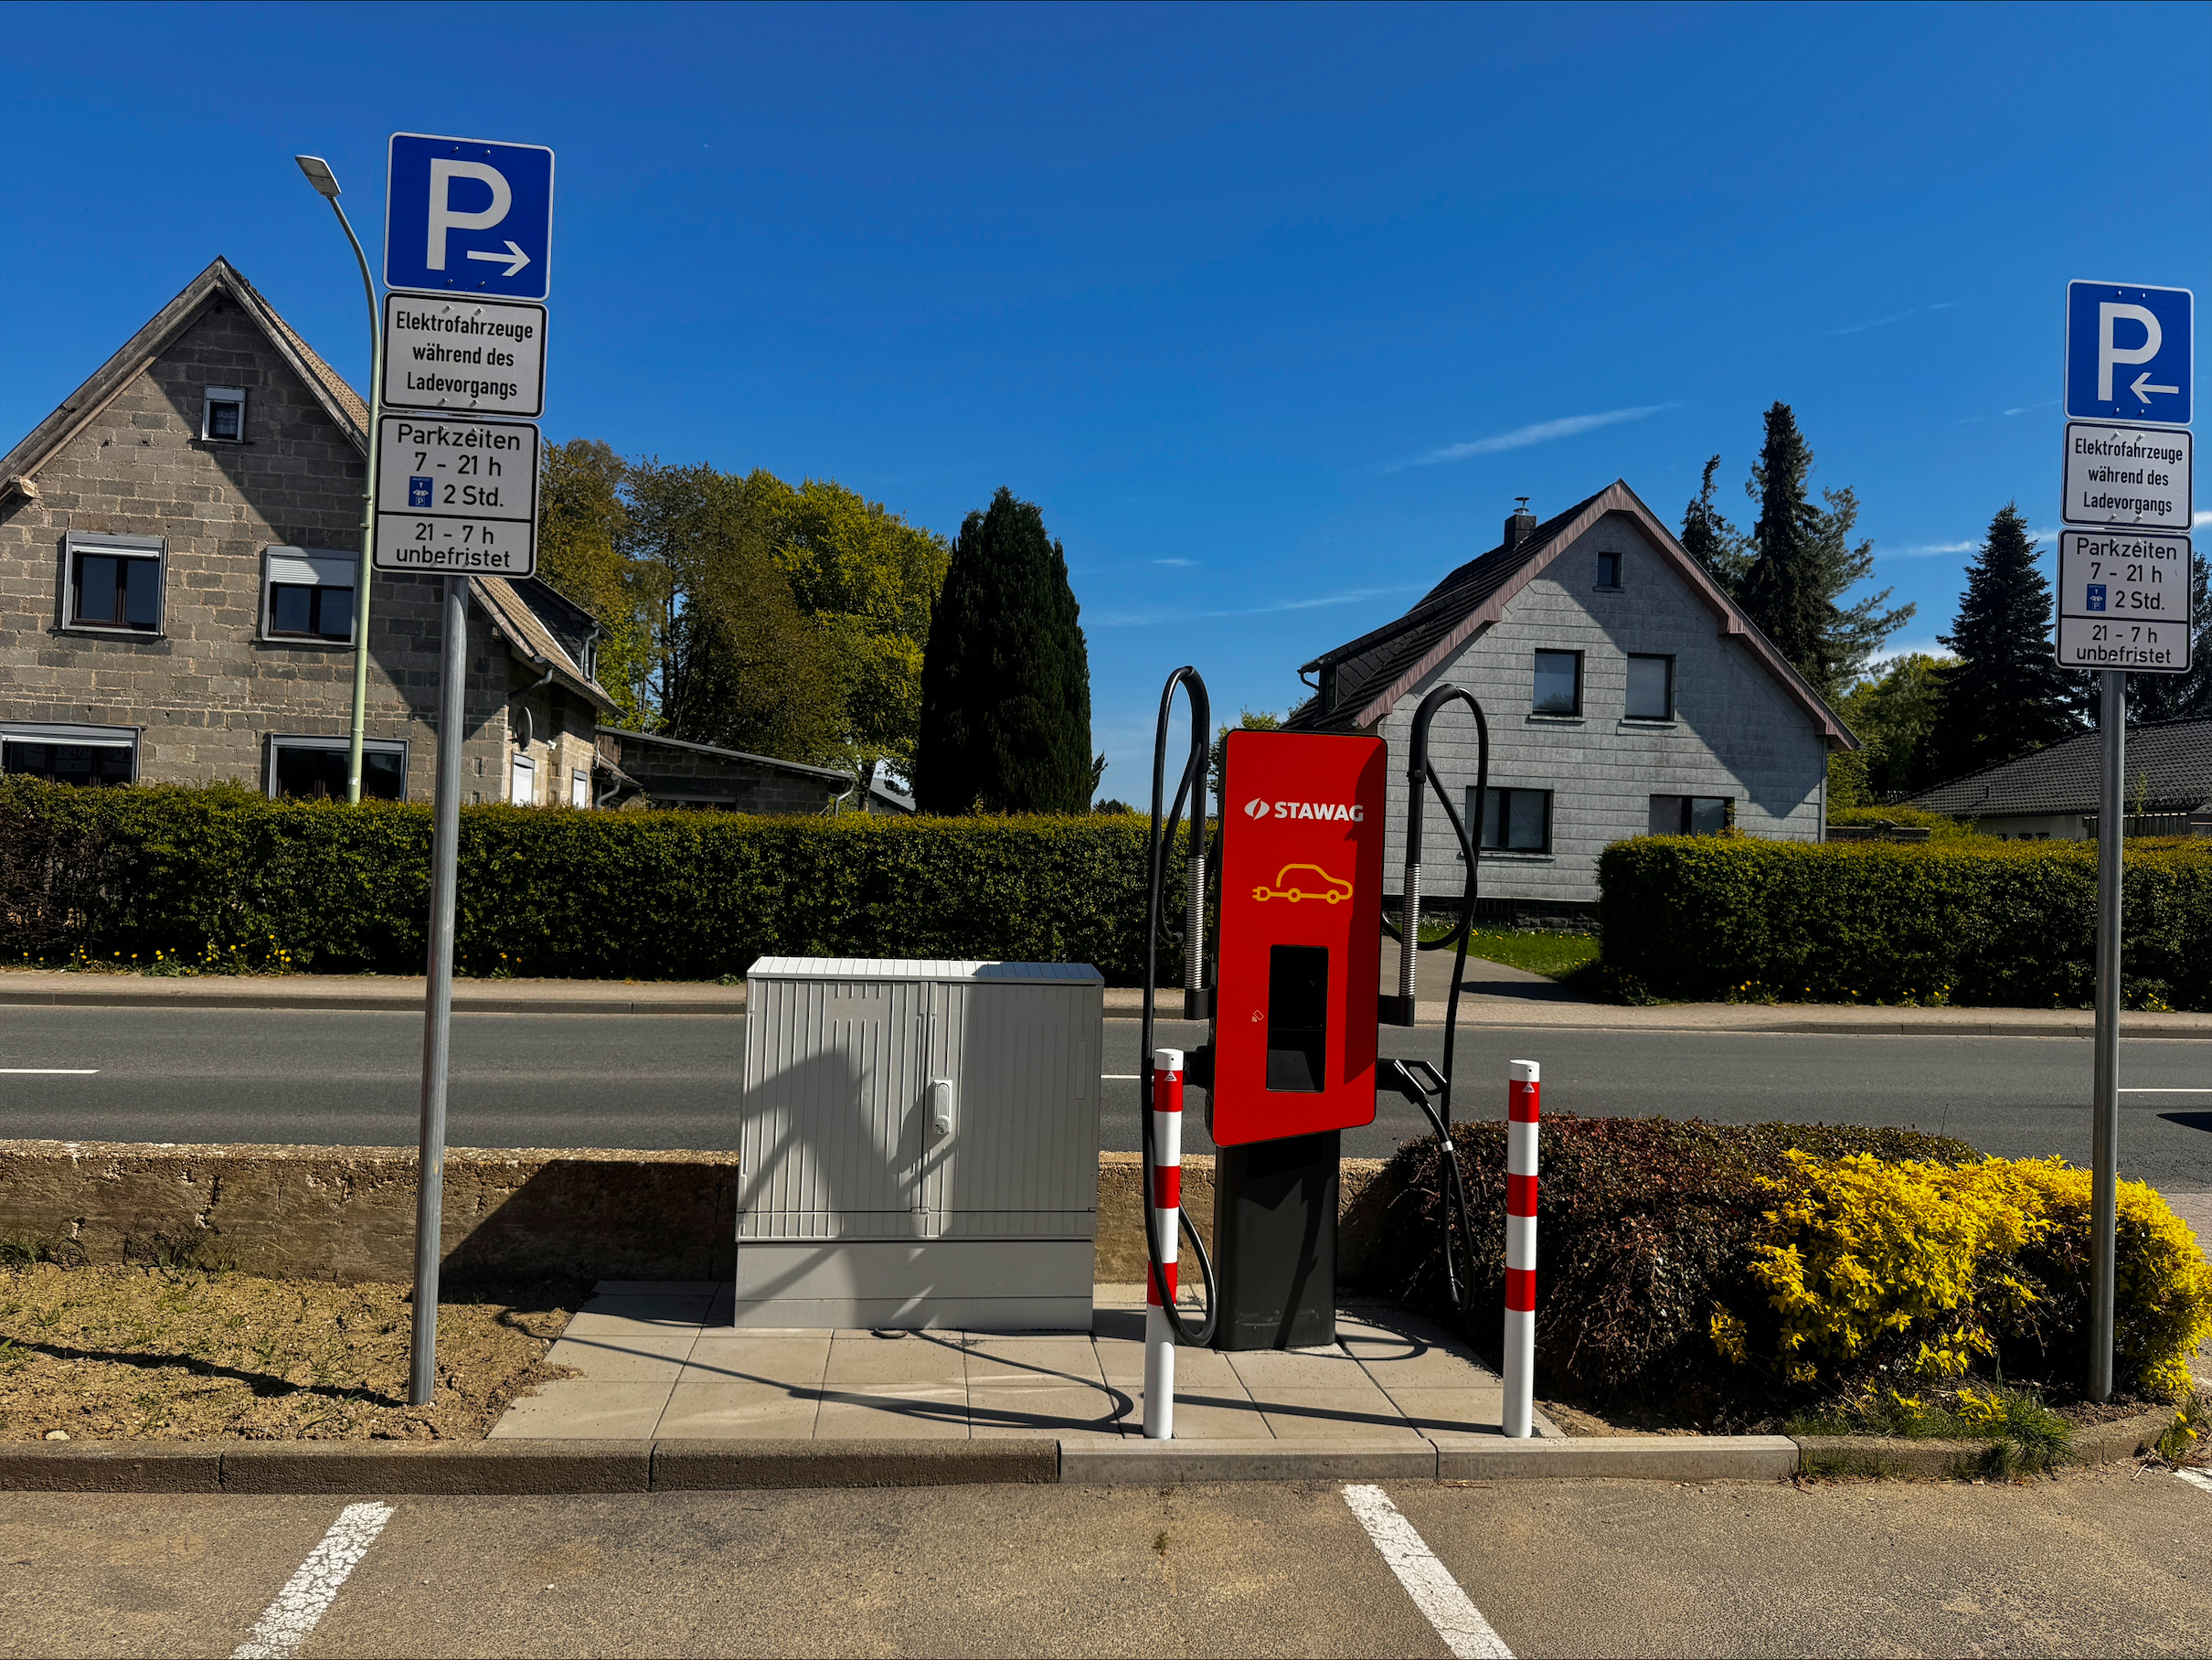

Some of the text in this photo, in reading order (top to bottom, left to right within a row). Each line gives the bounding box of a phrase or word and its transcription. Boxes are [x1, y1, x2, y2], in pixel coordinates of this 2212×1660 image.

[426, 157, 513, 271] P
[397, 311, 533, 342] Elektrofahrzeuge
[412, 343, 515, 367] während des
[2097, 301, 2164, 402] P
[407, 372, 517, 399] Ladevorgangs
[398, 423, 520, 451] Parkzeiten
[2075, 438, 2184, 463] Elektrofahrzeuge
[415, 452, 427, 472] 7
[457, 454, 478, 474] 21
[488, 456, 502, 477] h
[2088, 467, 2169, 487] während des
[442, 484, 505, 508] 2 Std.
[2083, 492, 2172, 515] Ladevorgangs
[415, 523, 433, 541] 21
[462, 525, 473, 544] 7
[482, 526, 495, 545] h
[396, 546, 511, 569] unbefristet
[2077, 537, 2176, 559] Parkzeiten
[2090, 562, 2101, 580] 7
[2126, 564, 2143, 581] 21
[2151, 565, 2163, 583] h
[2114, 591, 2164, 610] 2 Std.
[2091, 624, 2109, 641] 21
[2131, 626, 2141, 643] 7
[2147, 626, 2157, 644] h
[2077, 645, 2171, 664] unbefristet
[1274, 801, 1364, 822] STAWAG
